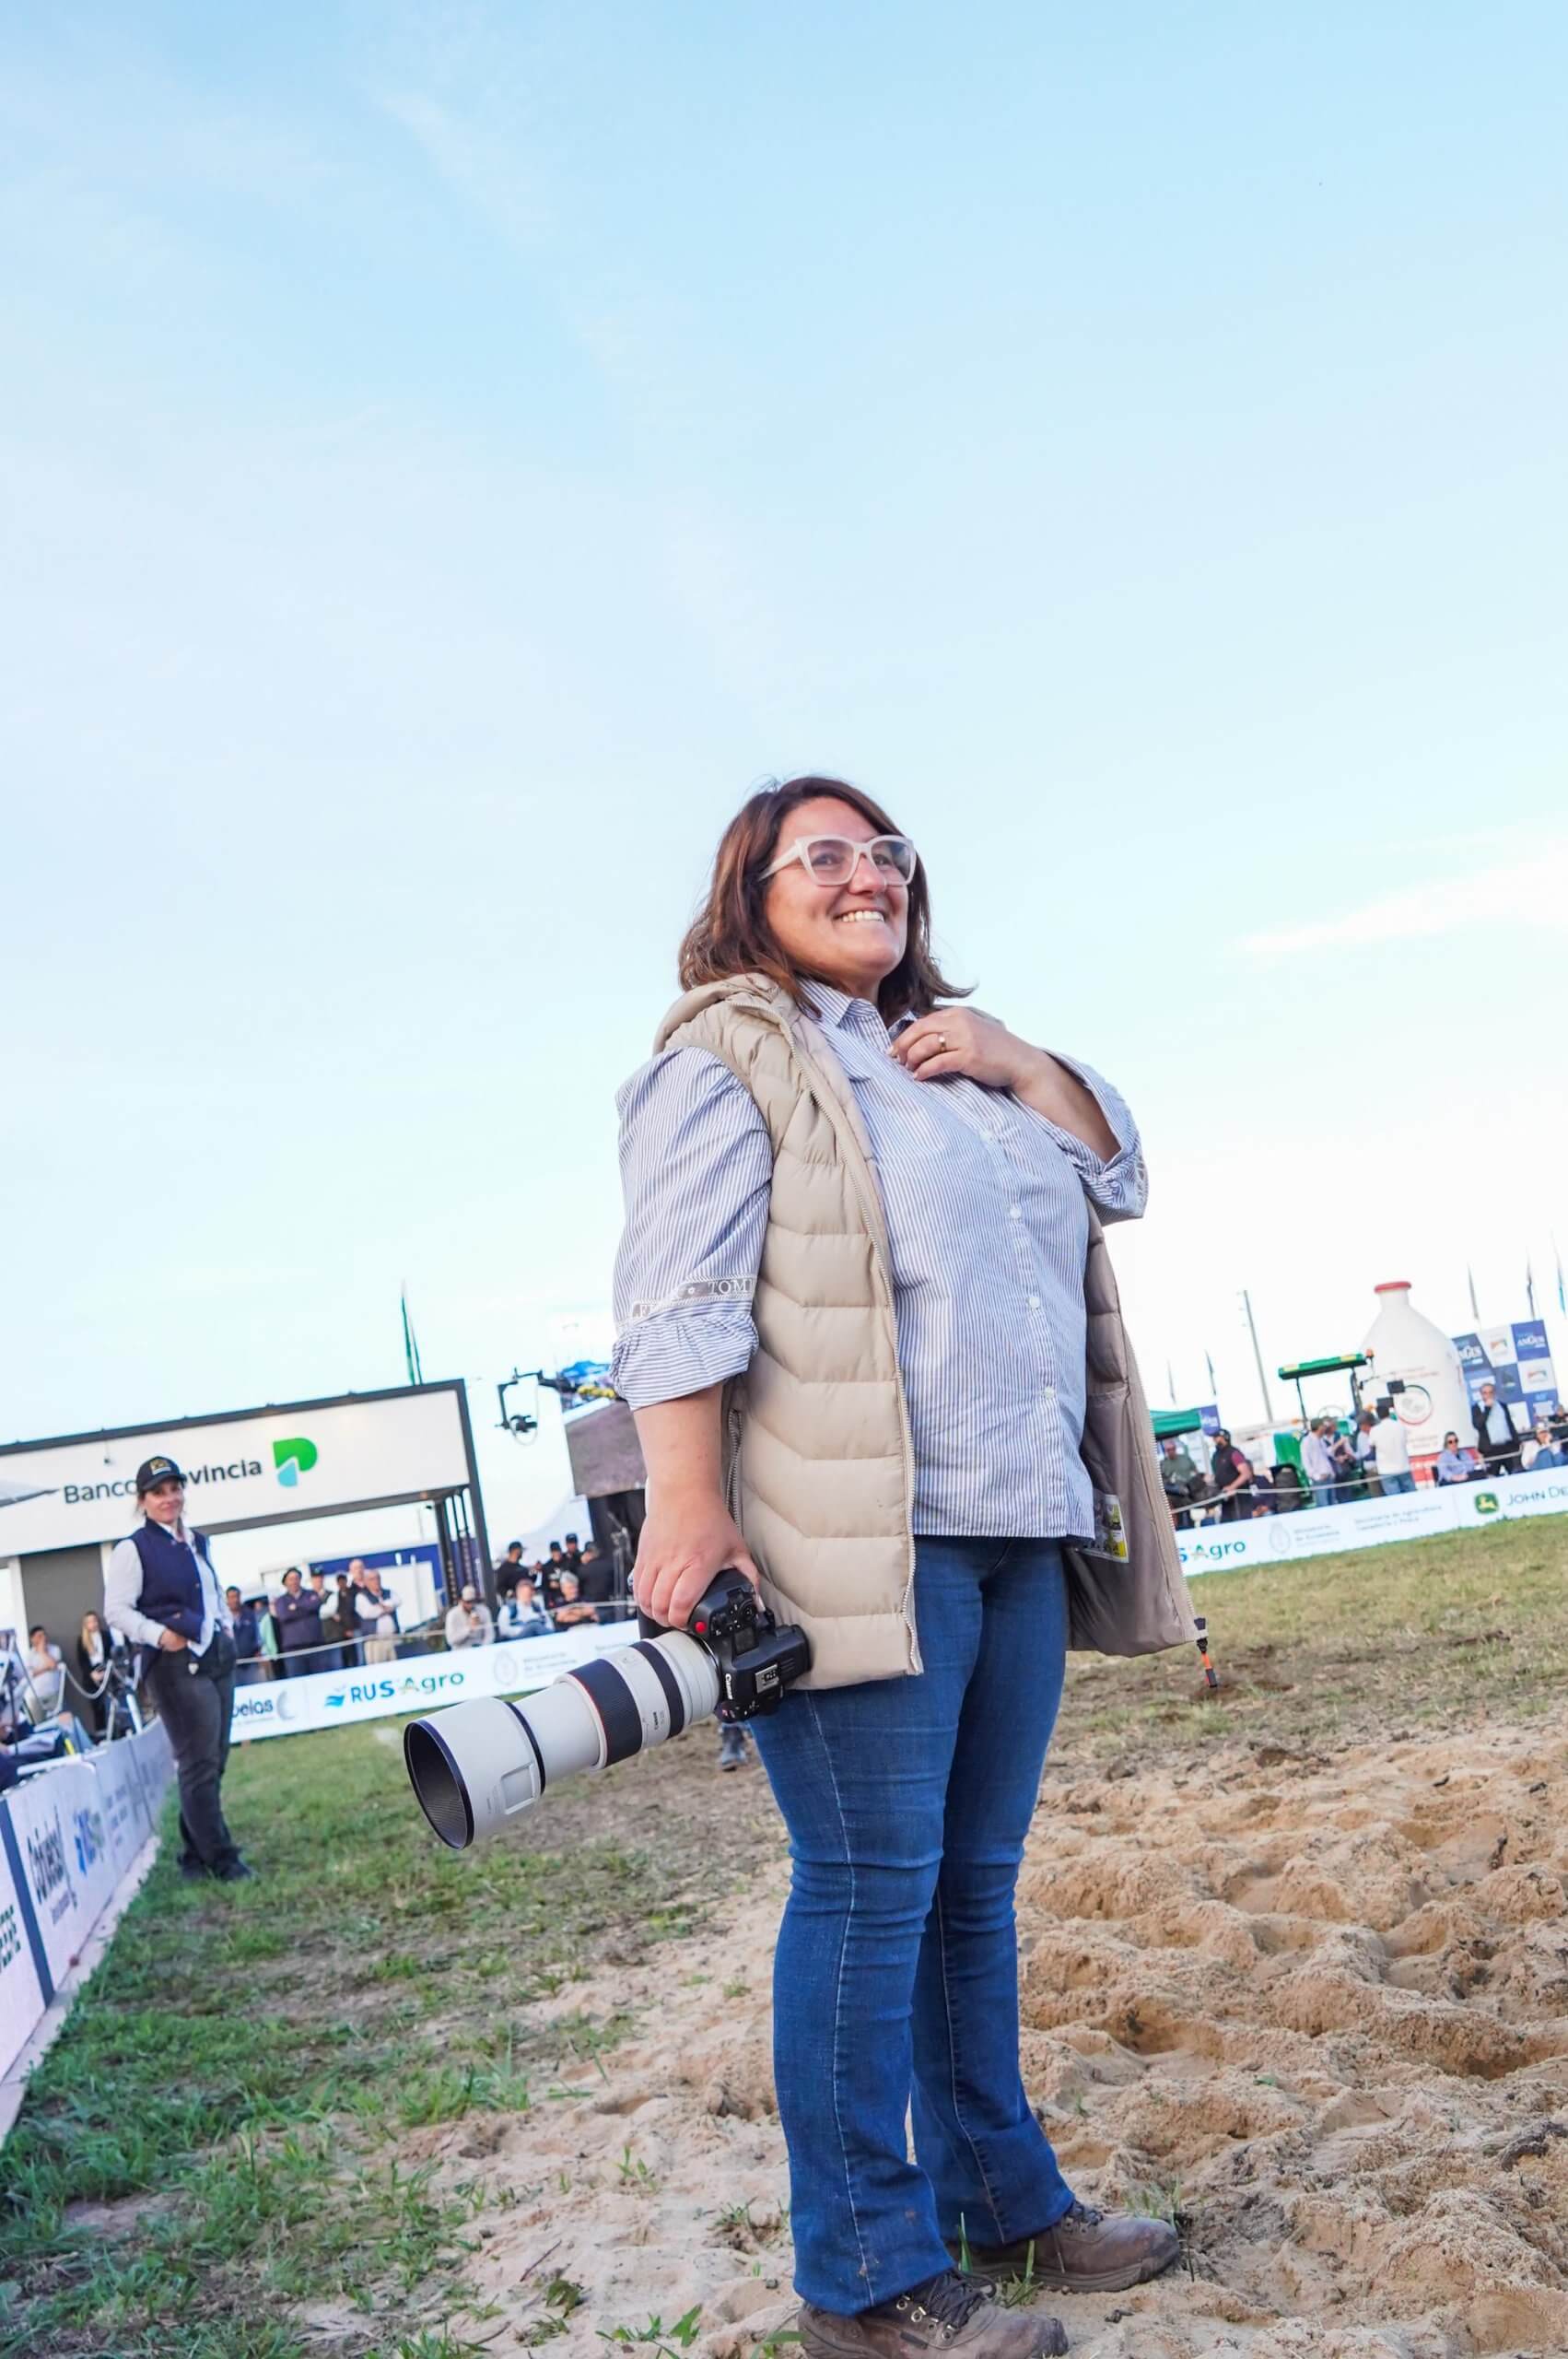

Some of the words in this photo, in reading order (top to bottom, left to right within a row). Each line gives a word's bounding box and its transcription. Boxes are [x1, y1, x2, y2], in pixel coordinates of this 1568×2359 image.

[64, 1480, 138, 1505] Banco
[182, 1460, 263, 1486] vincia
[1507, 1489, 1546, 1506] JOHN
[1191, 1540, 1246, 1560] Agro
[350, 1680, 396, 1703] RUS
[403, 1672, 465, 1694] Agro
